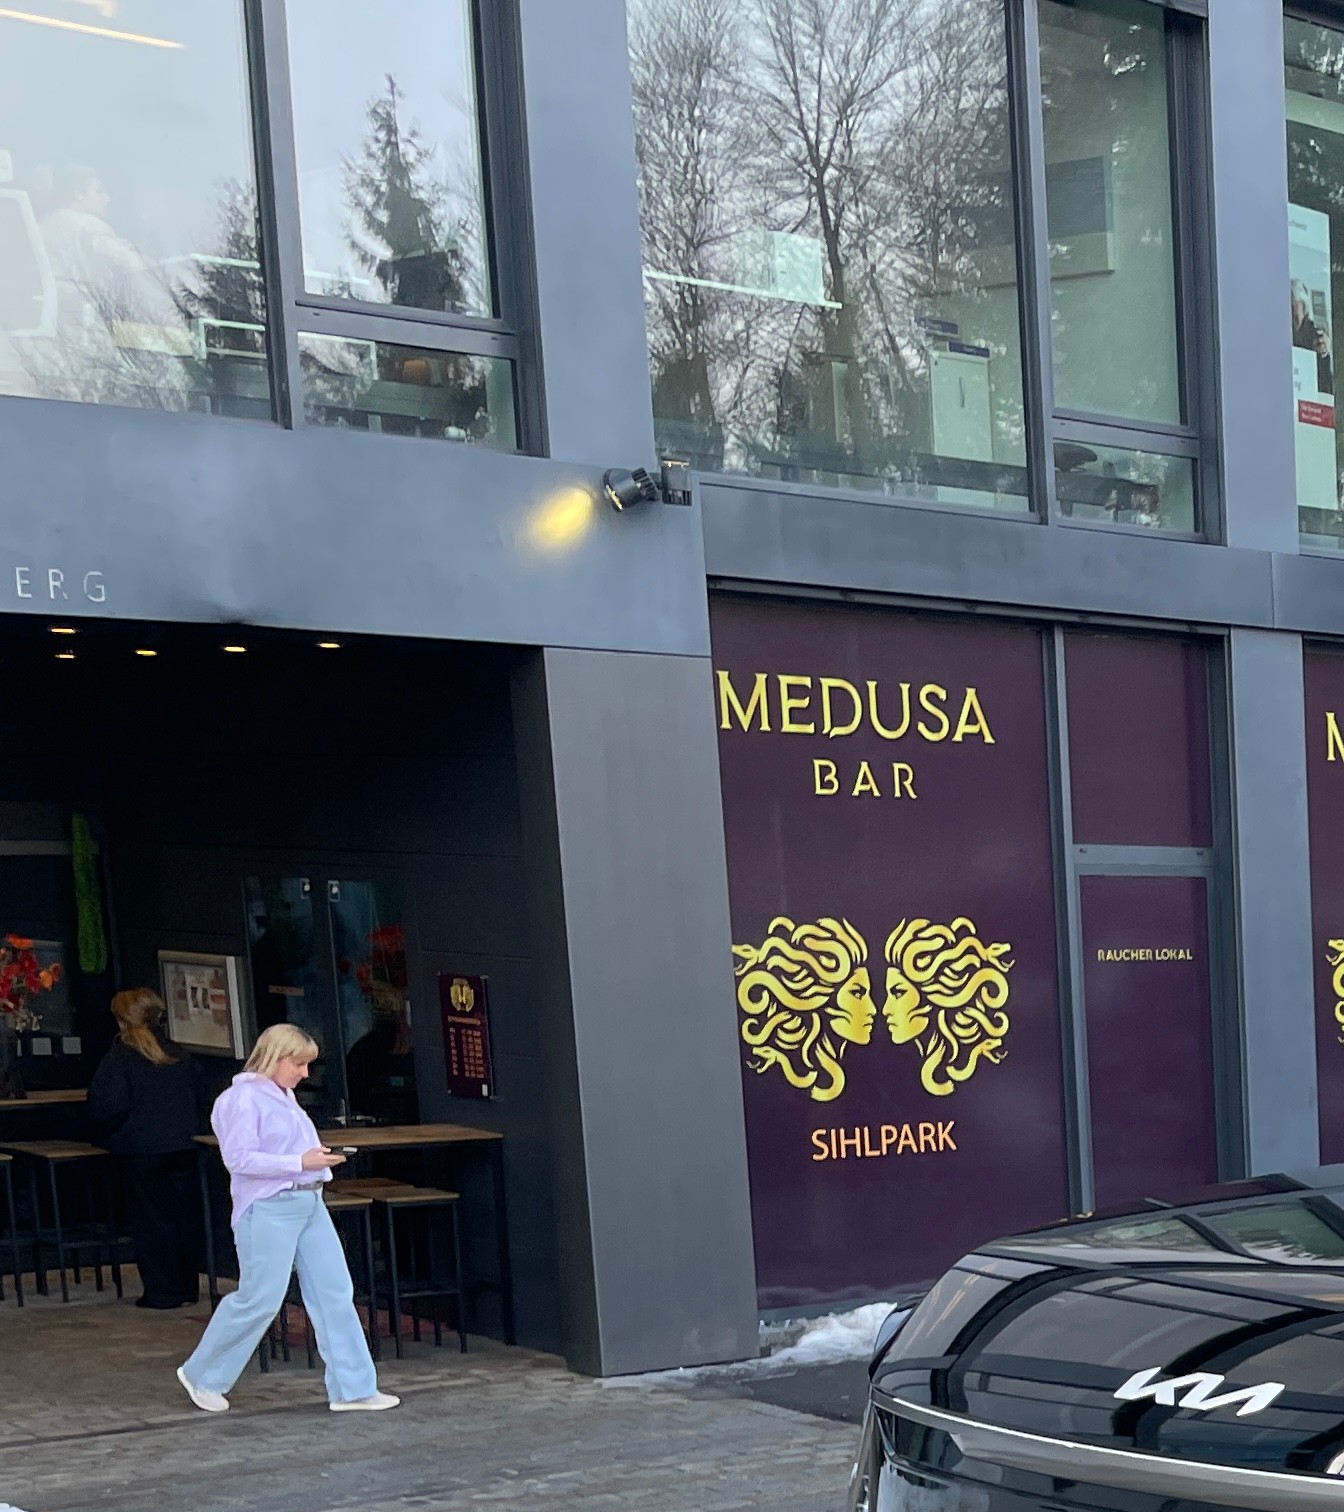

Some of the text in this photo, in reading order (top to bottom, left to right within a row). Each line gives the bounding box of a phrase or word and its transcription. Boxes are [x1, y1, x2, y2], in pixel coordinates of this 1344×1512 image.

[15, 566, 106, 603] ERG
[716, 670, 996, 744] MEDUSA
[813, 759, 918, 799] BAR
[1097, 948, 1193, 962] RAUCHER LOKAL
[811, 1120, 957, 1161] SIHLPARK
